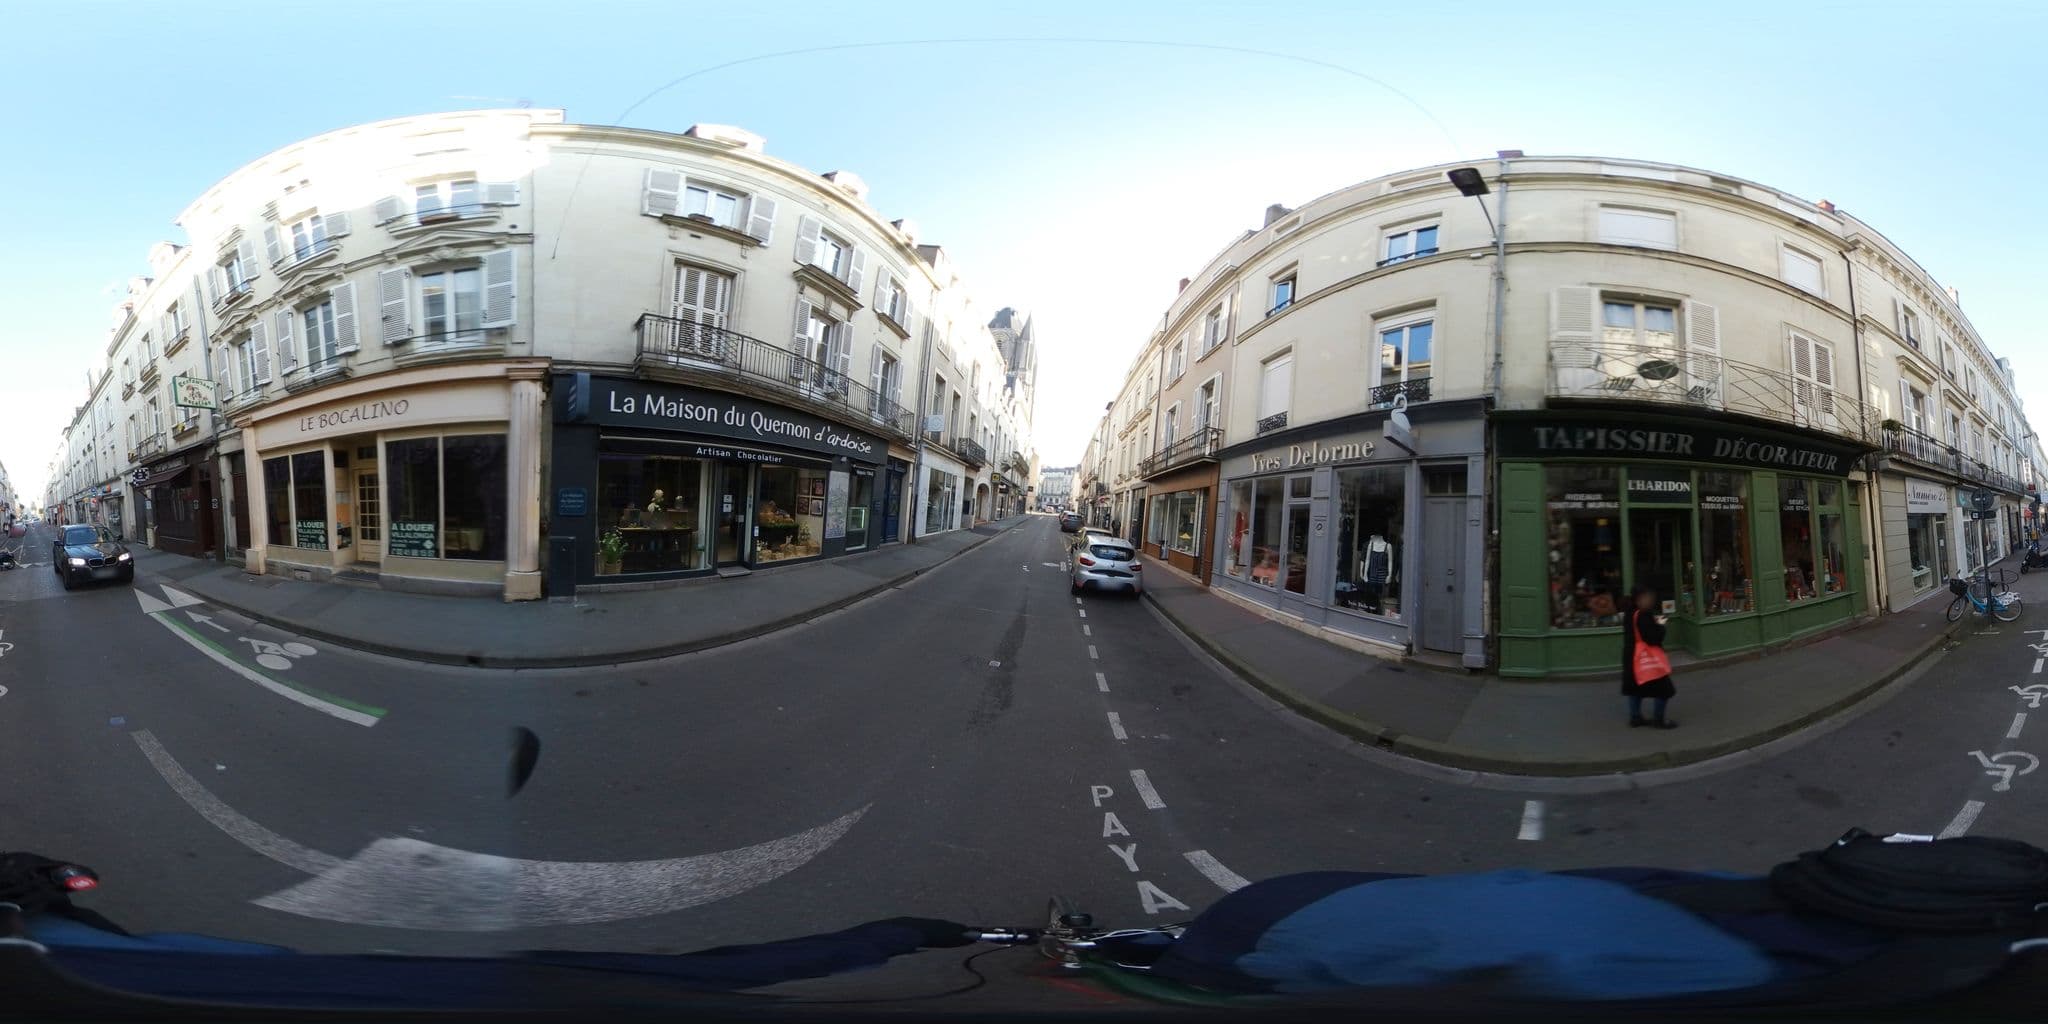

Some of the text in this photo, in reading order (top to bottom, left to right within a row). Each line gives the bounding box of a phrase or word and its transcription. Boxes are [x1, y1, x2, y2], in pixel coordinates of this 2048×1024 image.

[300, 399, 409, 431] LE BOCALINO
[610, 391, 872, 454] La Maison du Quernon d'ardoise
[696, 447, 782, 463] Artisan Chocolatier
[1533, 427, 1838, 471] TAPISSIER DÉCORATEUR
[1250, 441, 1374, 472] Yves Delorme
[1627, 479, 1691, 492] L'HARIDON
[1701, 502, 1722, 510] TISSUS
[1705, 495, 1739, 503] MOQUETTES
[303, 521, 325, 529] LOUER
[392, 523, 435, 532] A LOUER
